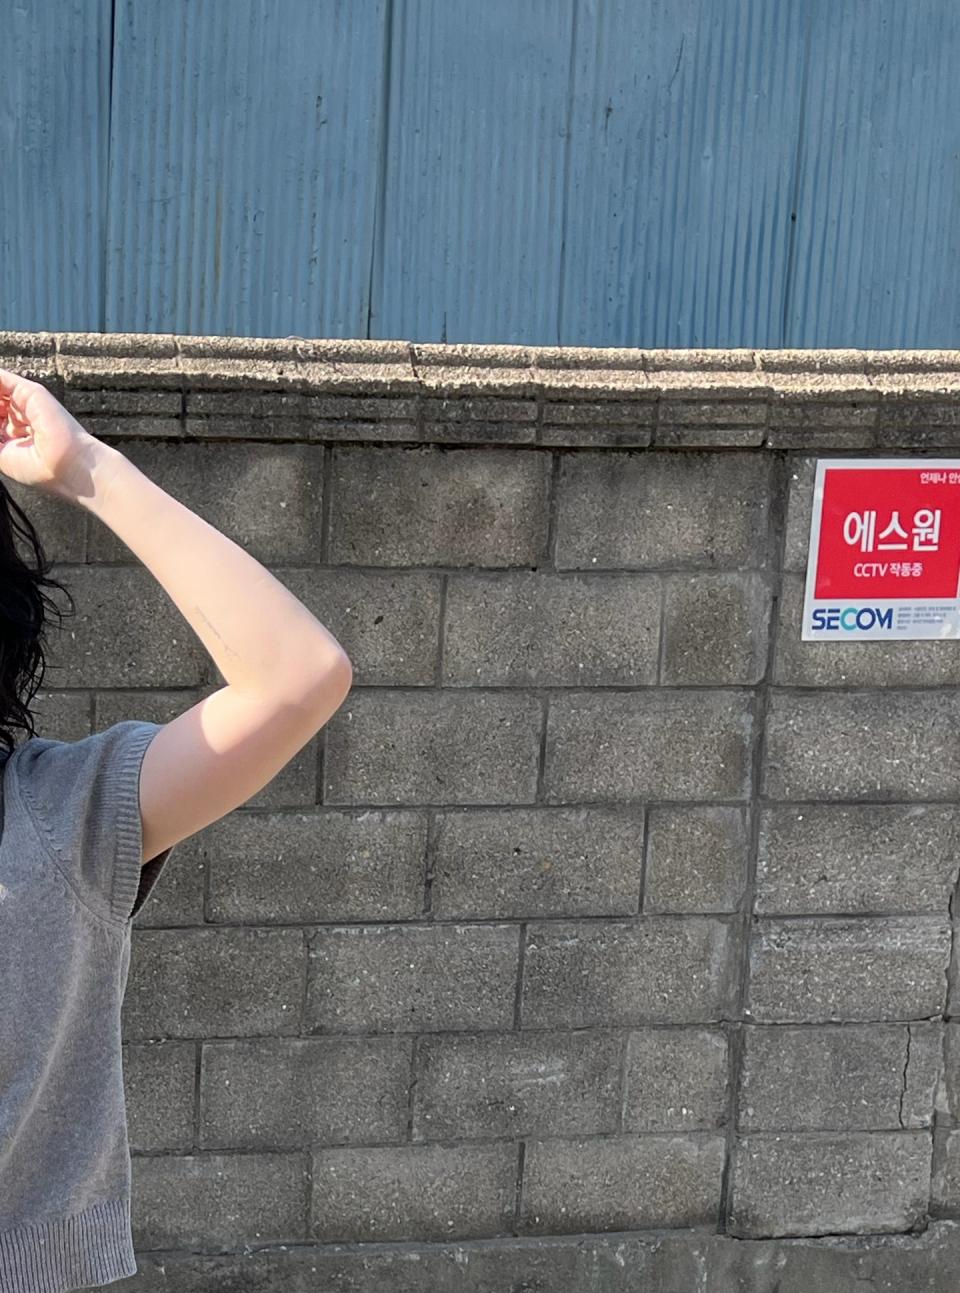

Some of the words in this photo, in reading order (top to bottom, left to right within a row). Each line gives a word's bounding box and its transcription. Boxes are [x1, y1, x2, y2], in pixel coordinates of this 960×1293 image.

[949, 472, 960, 485] 안
[843, 508, 942, 552] 에스원
[853, 562, 889, 577] CCTV
[889, 562, 924, 578] 작동중
[811, 607, 894, 631] SECOM
